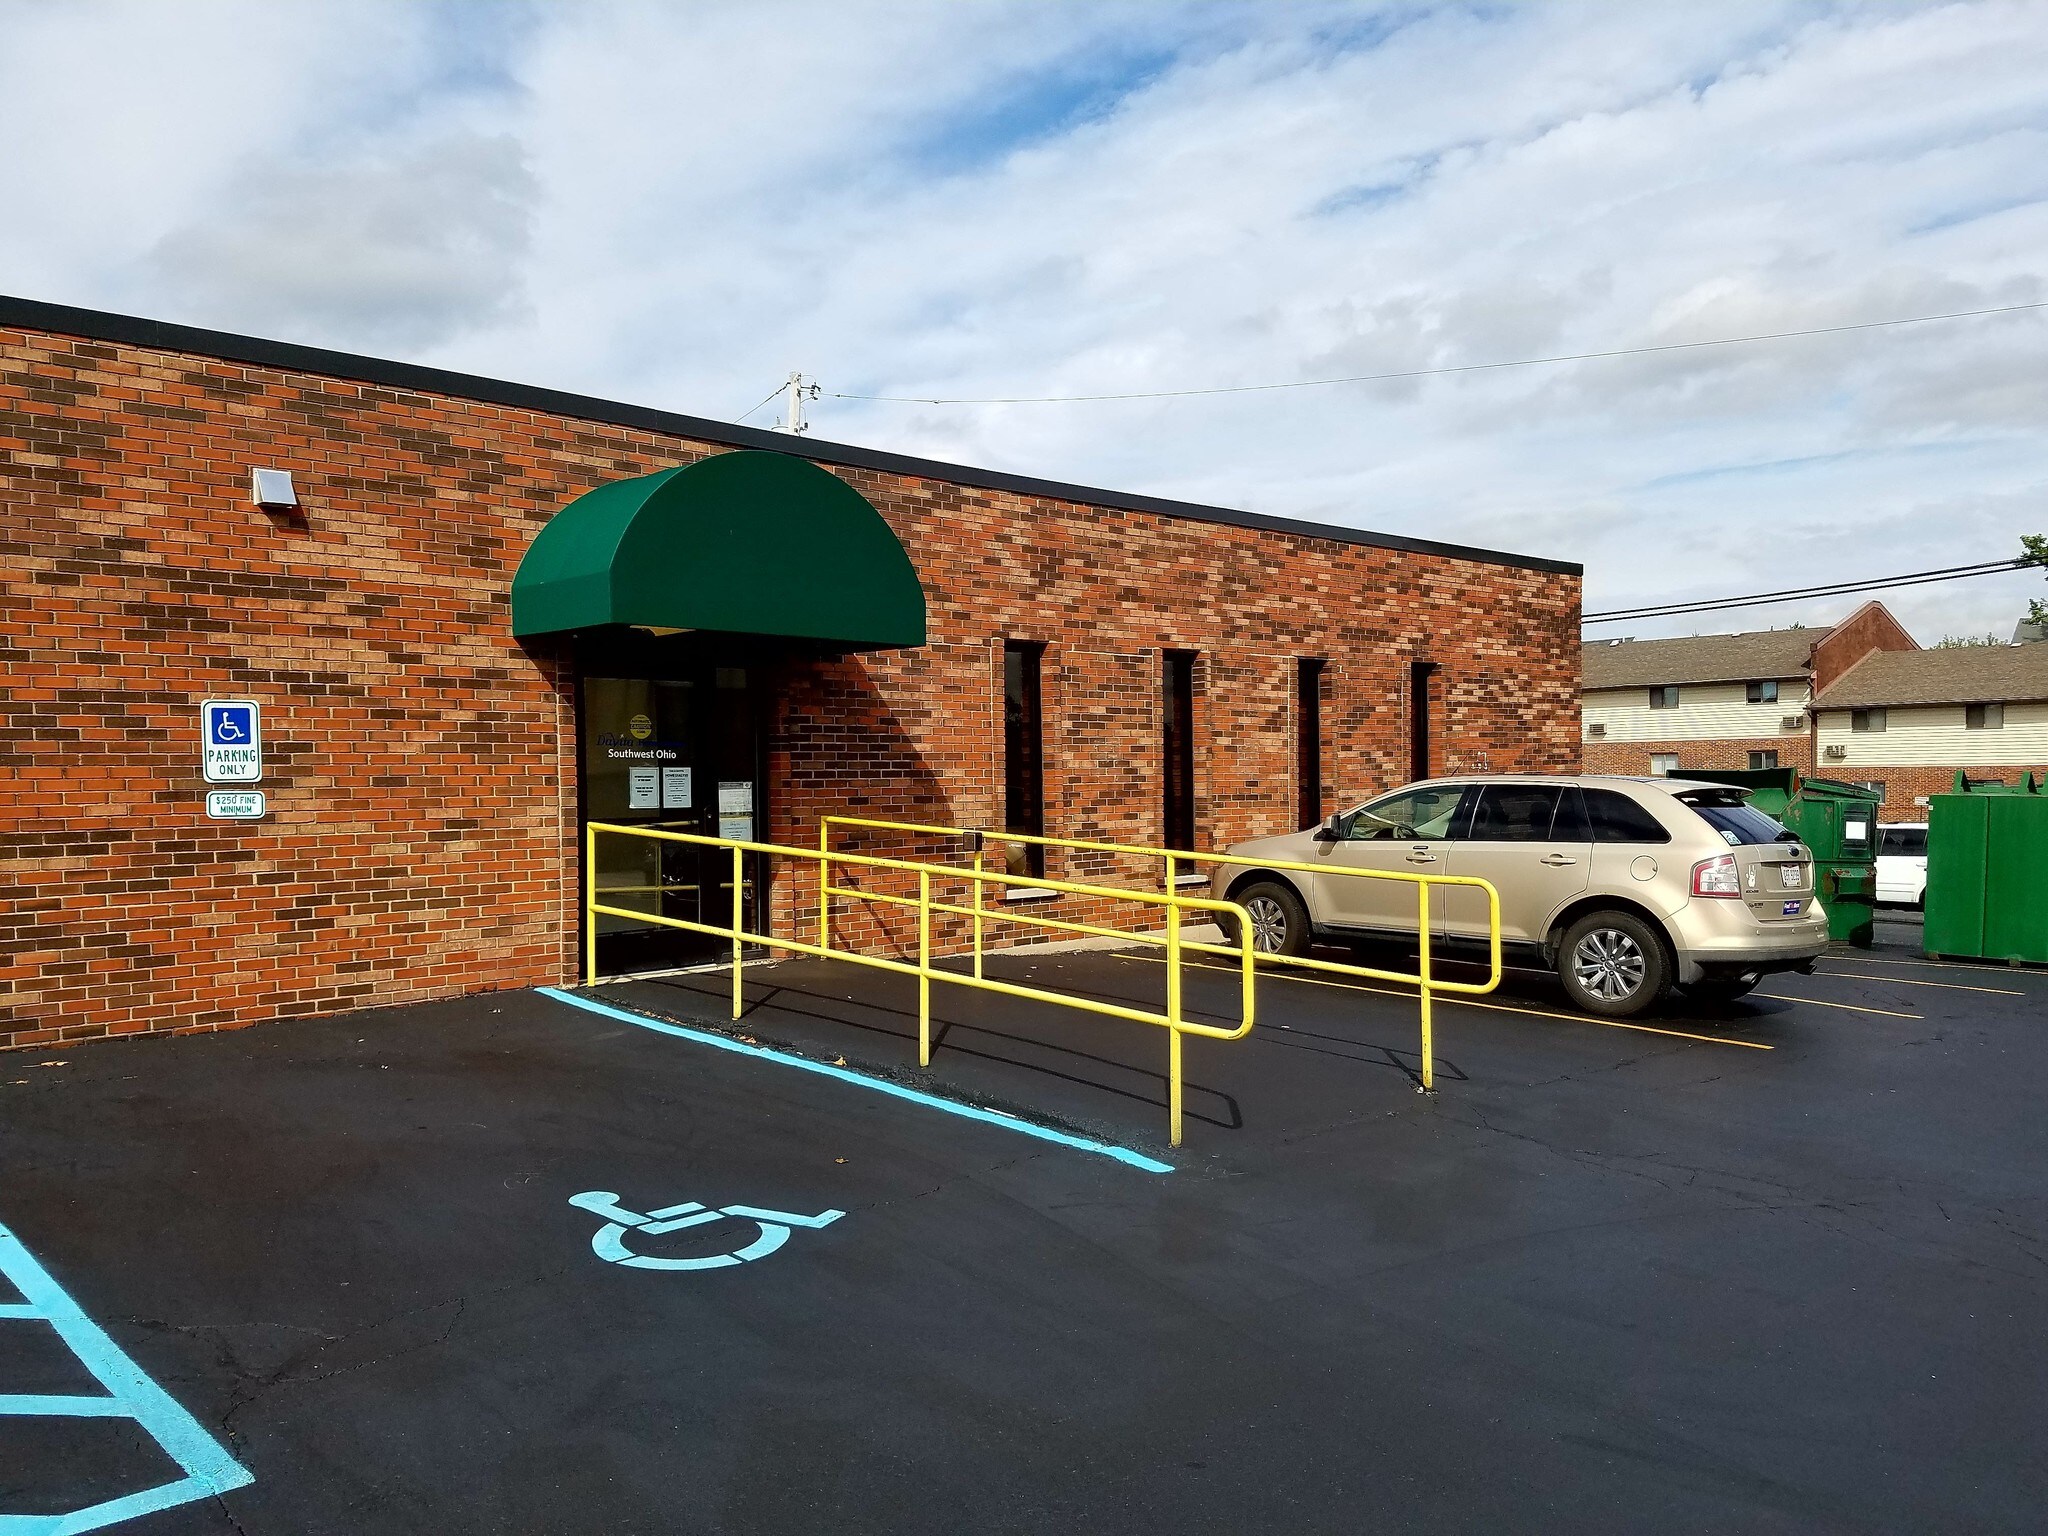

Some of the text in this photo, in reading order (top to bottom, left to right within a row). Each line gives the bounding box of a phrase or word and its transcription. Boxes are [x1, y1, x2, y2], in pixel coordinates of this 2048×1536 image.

[208, 749, 256, 762] PARKING
[608, 748, 677, 759] Southwest Ohio
[219, 764, 247, 775] ONLY
[216, 796, 257, 805] $250 FINE
[220, 805, 252, 814] MINIMUM
